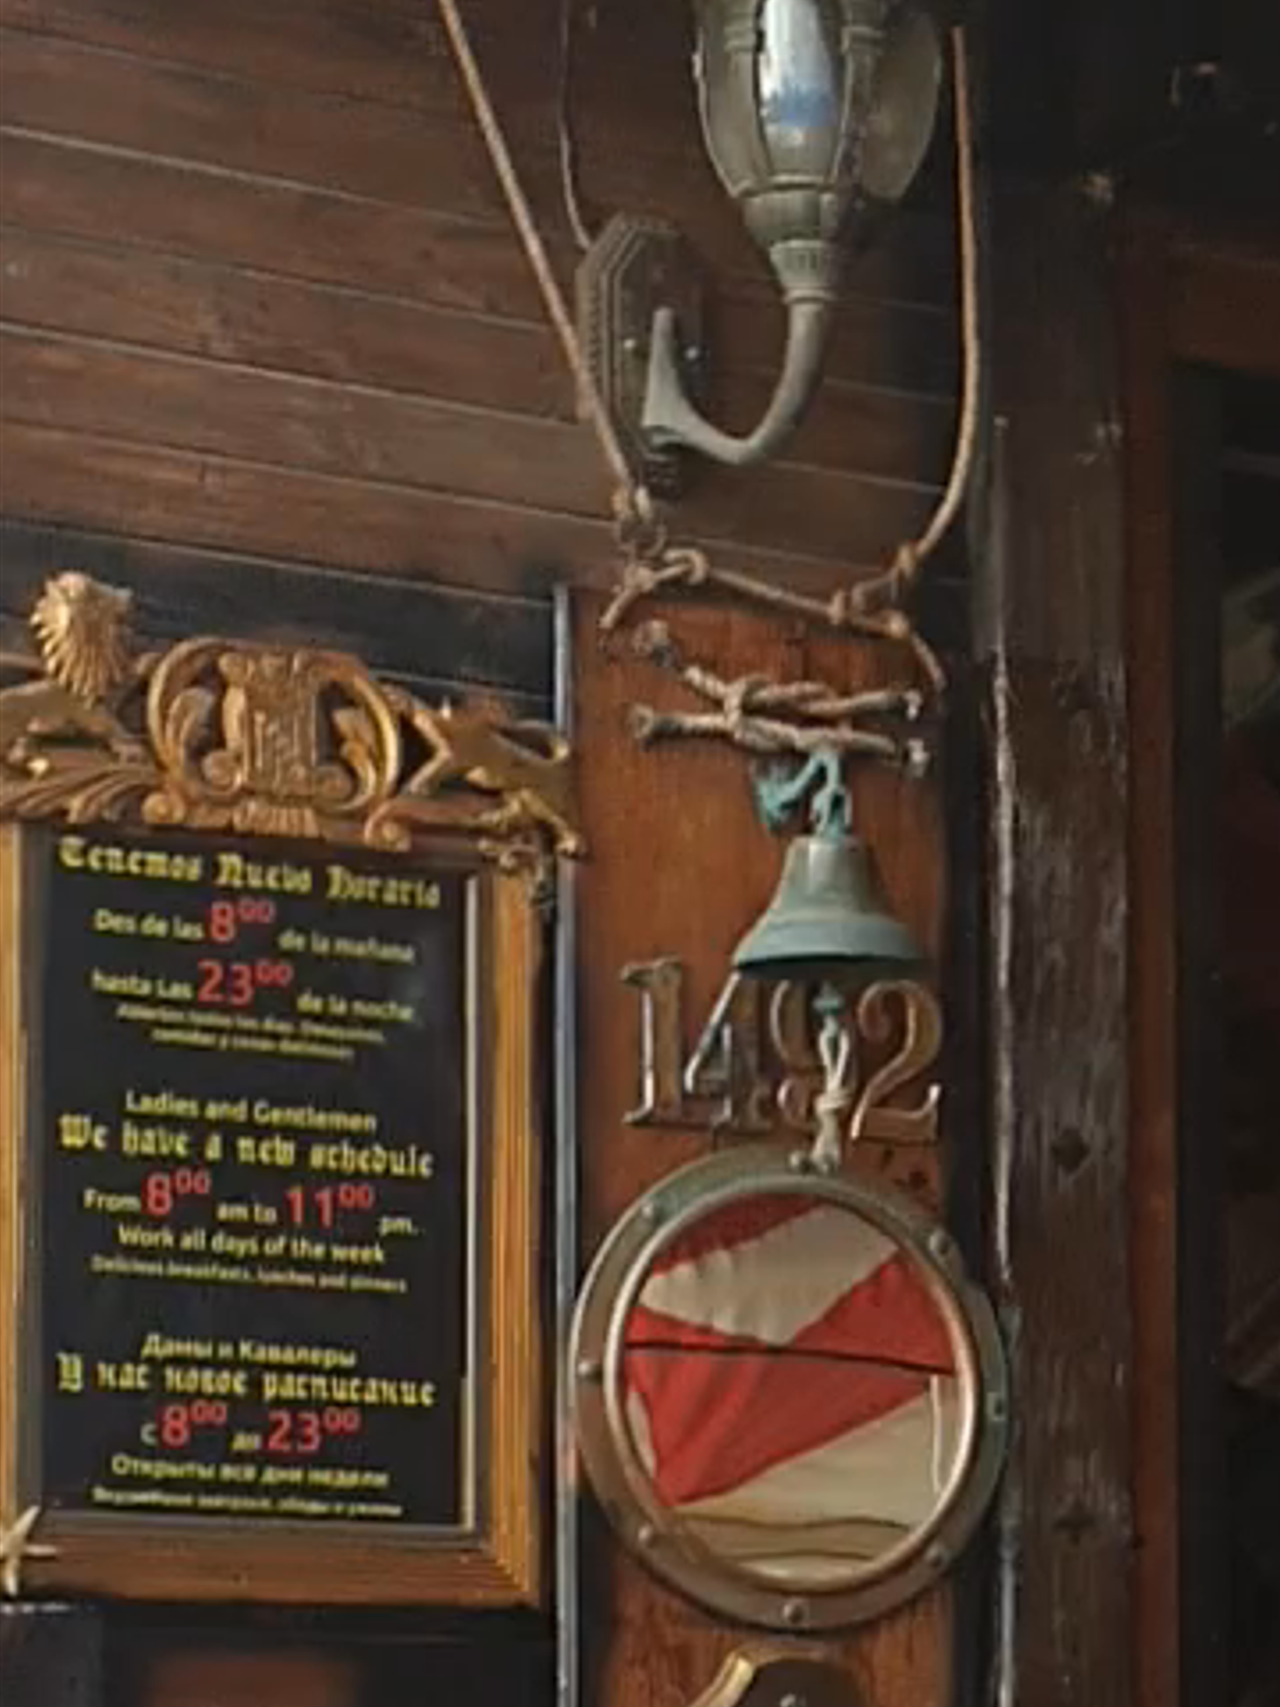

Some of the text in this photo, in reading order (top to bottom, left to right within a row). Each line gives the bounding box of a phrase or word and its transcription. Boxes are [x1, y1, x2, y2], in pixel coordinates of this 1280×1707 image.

[57, 833, 442, 910] Tenemos Nuevo Horario
[93, 907, 138, 935] Des
[140, 909, 169, 937] de
[278, 928, 307, 951] de
[125, 1089, 377, 1133] Ladies and Gentlemen
[57, 1114, 434, 1180] We have a new schedule
[83, 1188, 141, 1214] From
[216, 1203, 250, 1224] am
[253, 1202, 278, 1225] to
[117, 1225, 174, 1250] Work
[210, 1231, 260, 1260] days
[331, 1237, 386, 1265] week
[140, 1331, 214, 1360] Дамы
